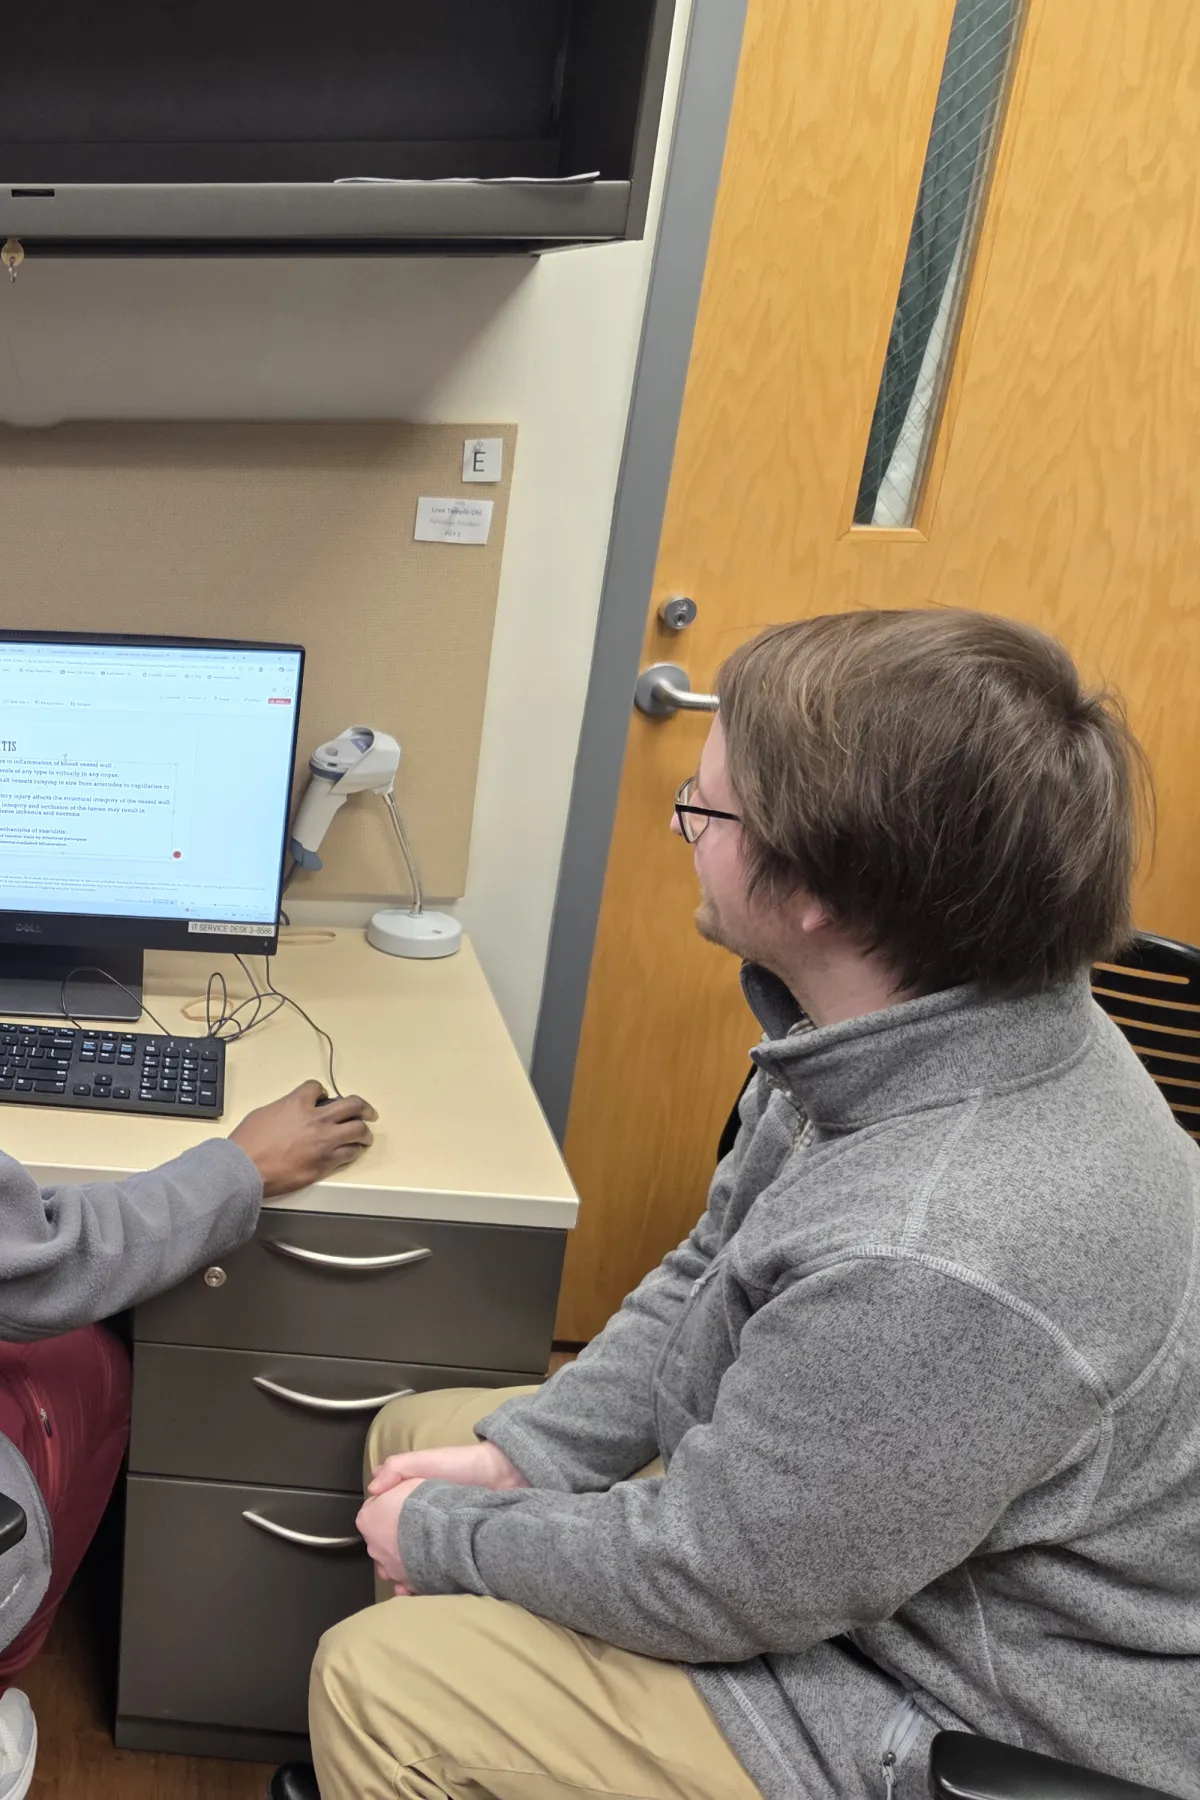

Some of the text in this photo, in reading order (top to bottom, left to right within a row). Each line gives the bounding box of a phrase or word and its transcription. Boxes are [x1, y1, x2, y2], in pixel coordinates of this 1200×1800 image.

[473, 452, 486, 472] E
[15, 923, 42, 933] DELL
[200, 924, 228, 932] SERVICE
